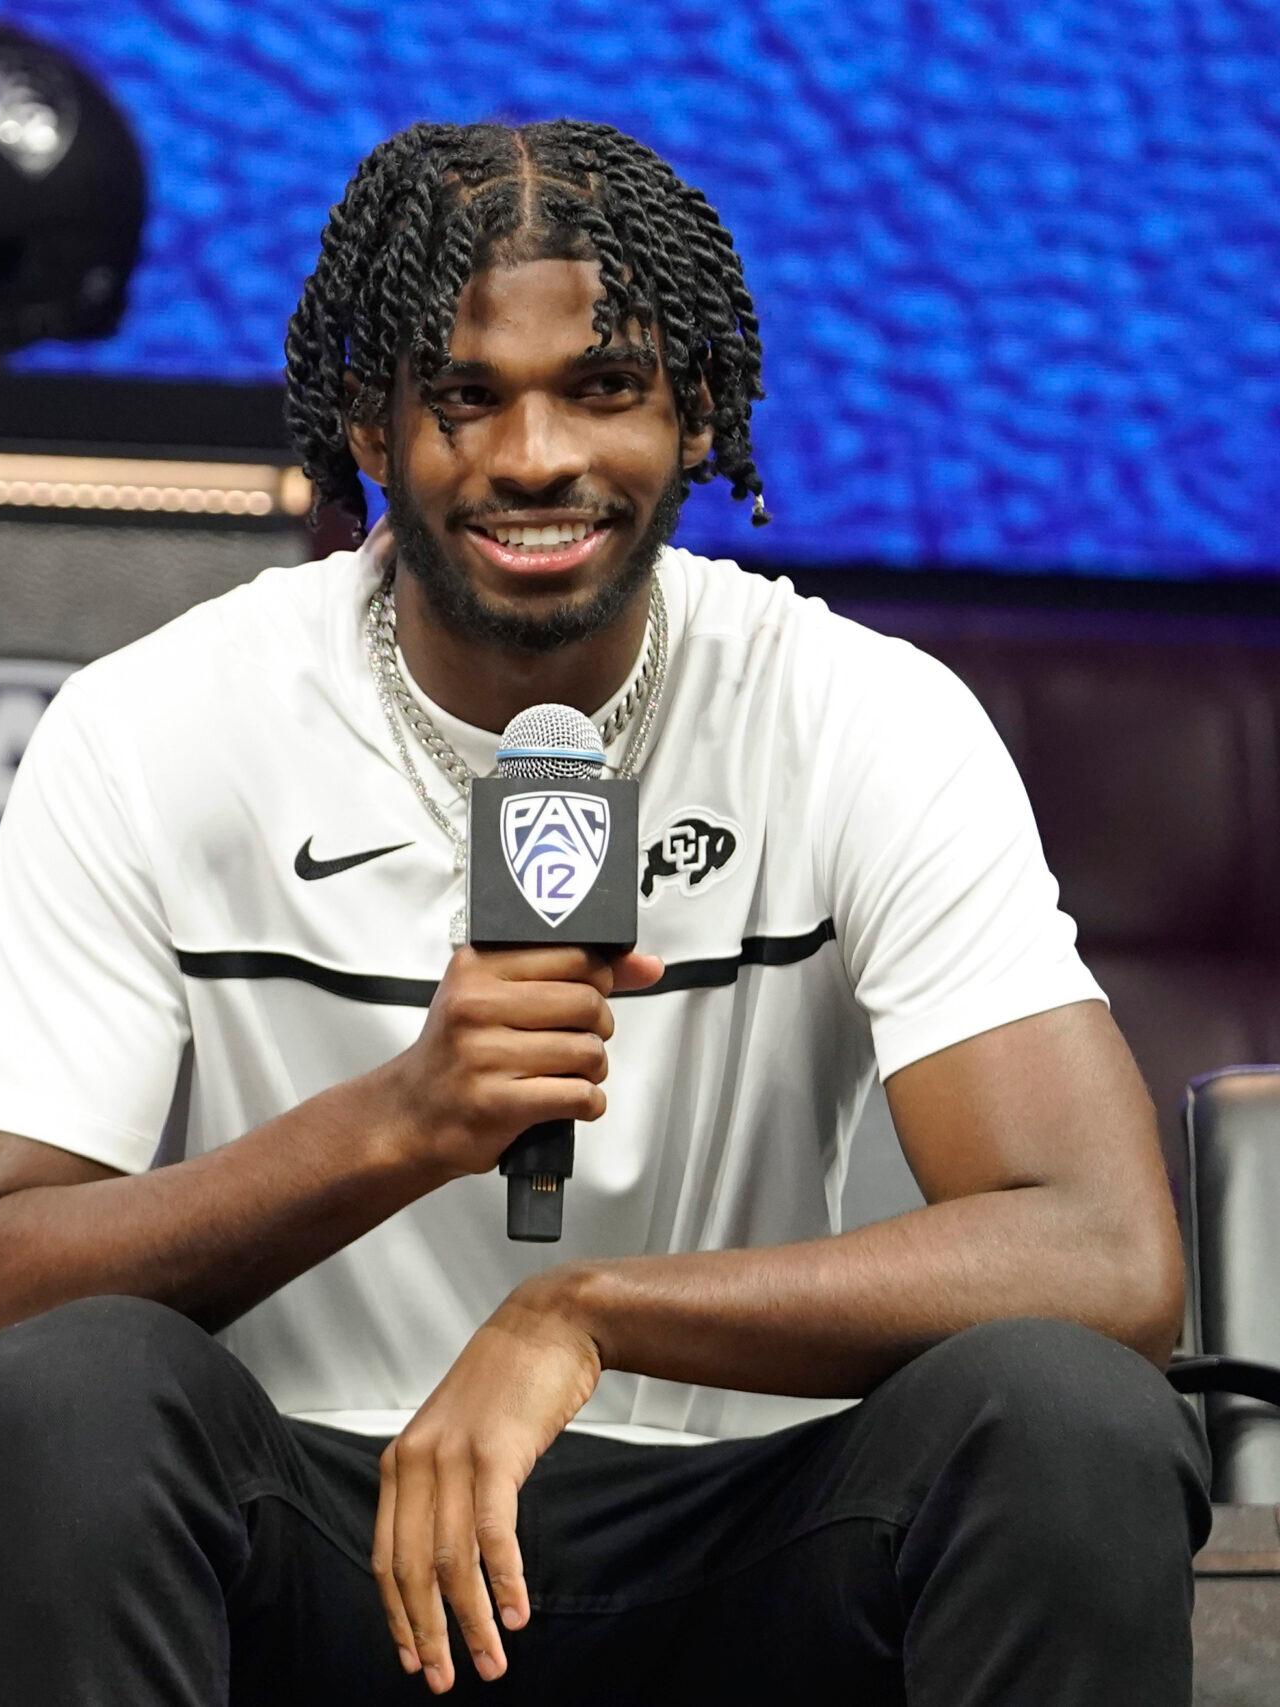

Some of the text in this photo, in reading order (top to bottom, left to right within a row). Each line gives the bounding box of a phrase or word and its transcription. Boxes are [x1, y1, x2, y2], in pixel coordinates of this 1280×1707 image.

[504, 797, 605, 874] PAC
[662, 824, 709, 872] CU
[536, 863, 576, 899] 12
